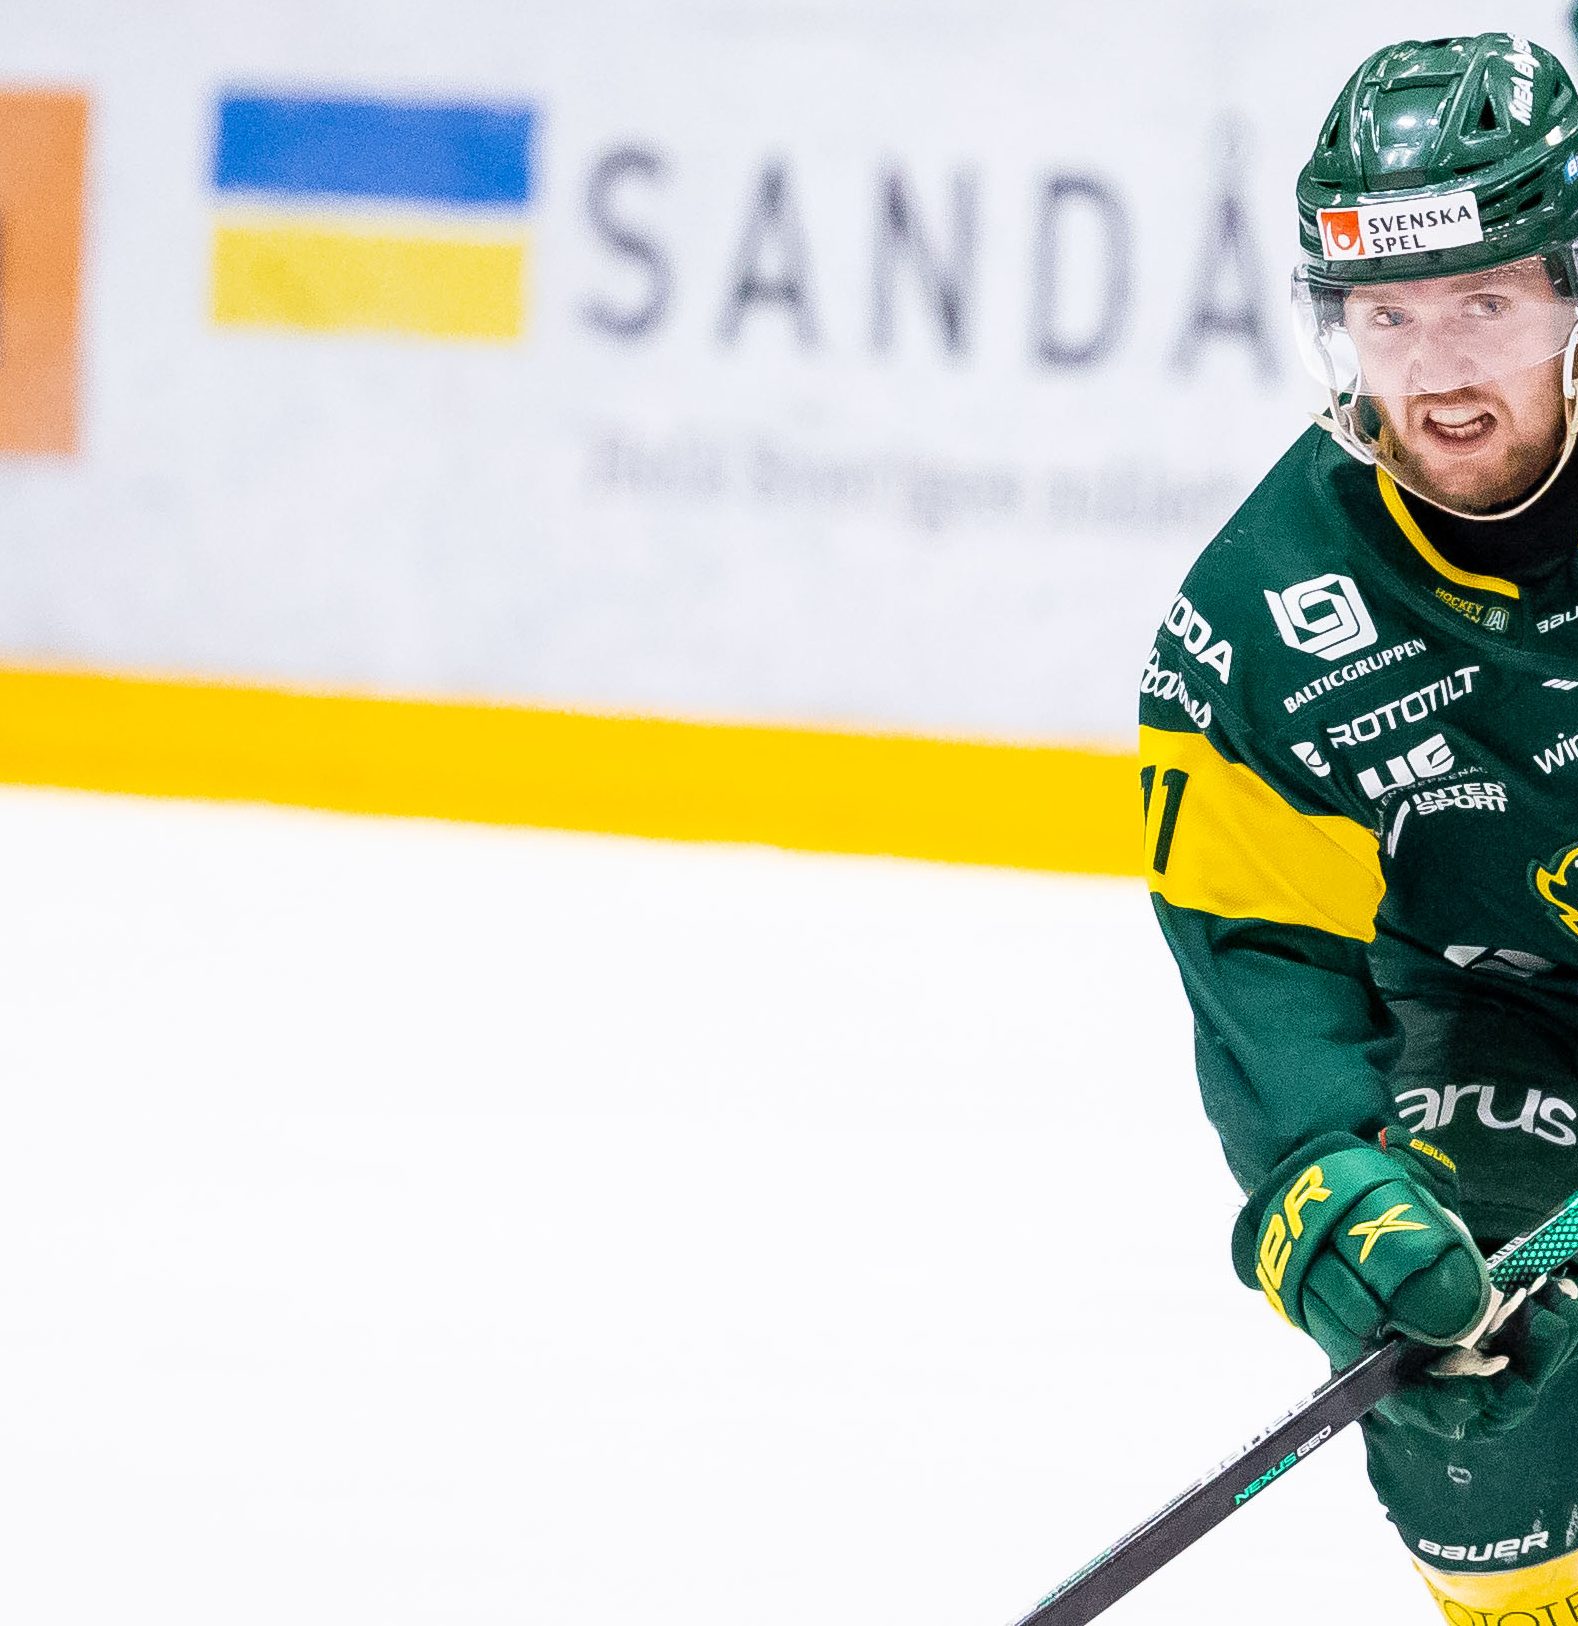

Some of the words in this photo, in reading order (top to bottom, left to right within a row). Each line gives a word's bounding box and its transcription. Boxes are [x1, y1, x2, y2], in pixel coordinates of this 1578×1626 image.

[1368, 205, 1473, 235] SVENSKA
[577, 113, 1284, 387] SANDÅ
[1374, 234, 1427, 255] SPEL
[1435, 587, 1484, 616] HOCKEY
[1164, 592, 1233, 685] ODA
[1283, 638, 1427, 714] BALTICGRUPPEN
[1327, 666, 1480, 749] ROTOTILT
[1412, 782, 1506, 805] INTER
[1417, 796, 1509, 816] SPORT
[1395, 1085, 1577, 1145] arus
[1234, 1452, 1297, 1505] NEXUS
[1296, 1425, 1332, 1456] GEO
[1418, 1530, 1550, 1562] BAUER
